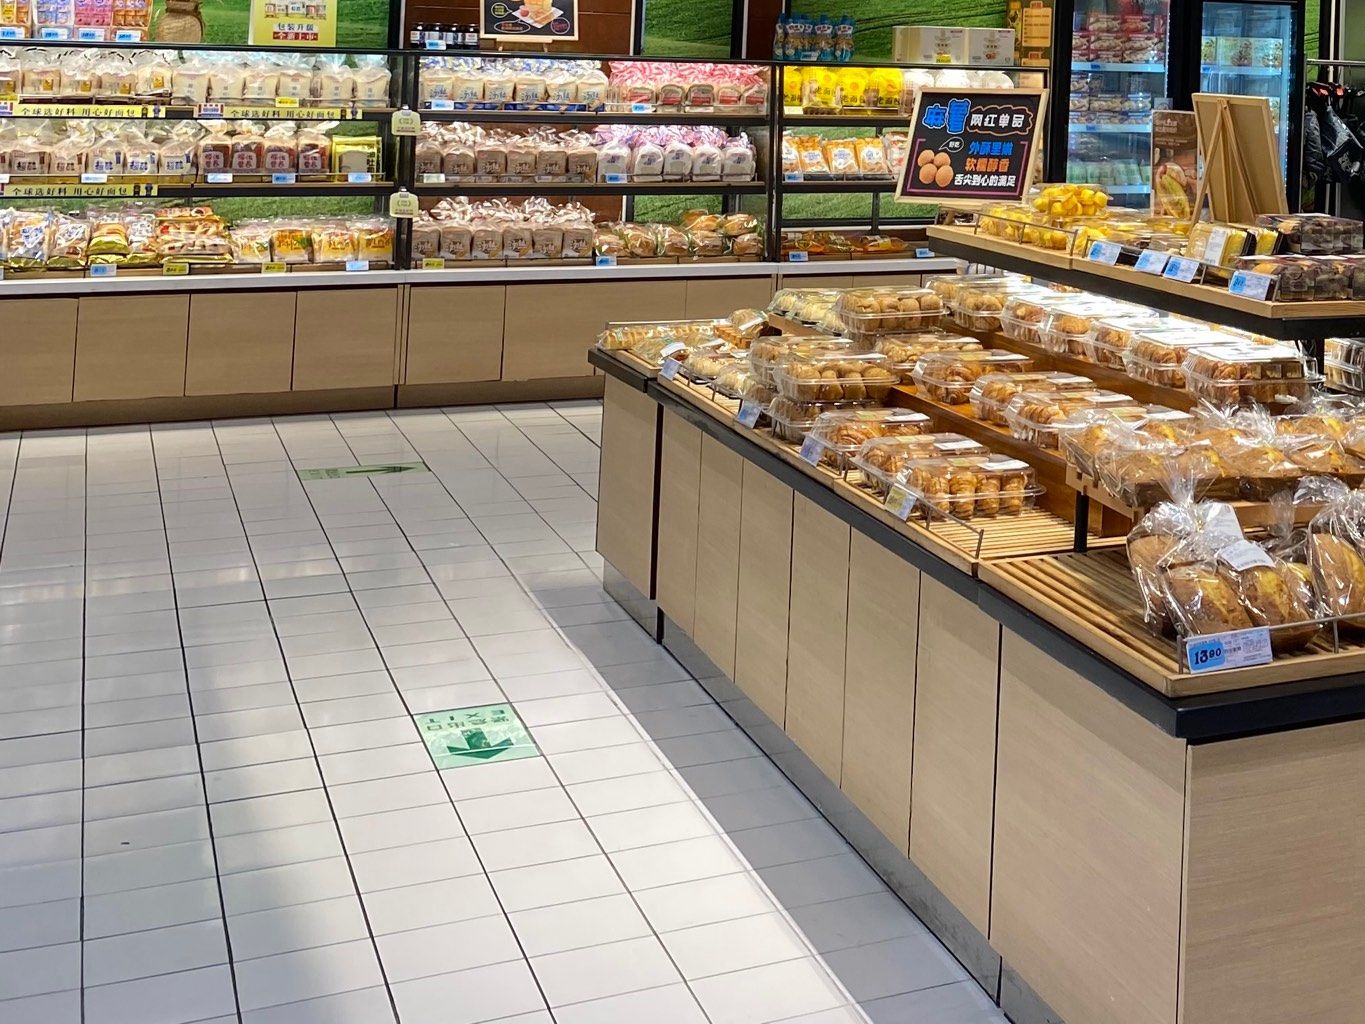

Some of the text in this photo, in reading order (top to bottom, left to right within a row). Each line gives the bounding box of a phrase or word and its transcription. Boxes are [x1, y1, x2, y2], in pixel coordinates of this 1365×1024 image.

[21, 107, 135, 117] 全球选好料 用心好面包
[970, 114, 1025, 128] 网红单品
[954, 173, 1017, 187] 舌尖到心的满足
[12, 187, 128, 196] 全球选好料 用心好面包
